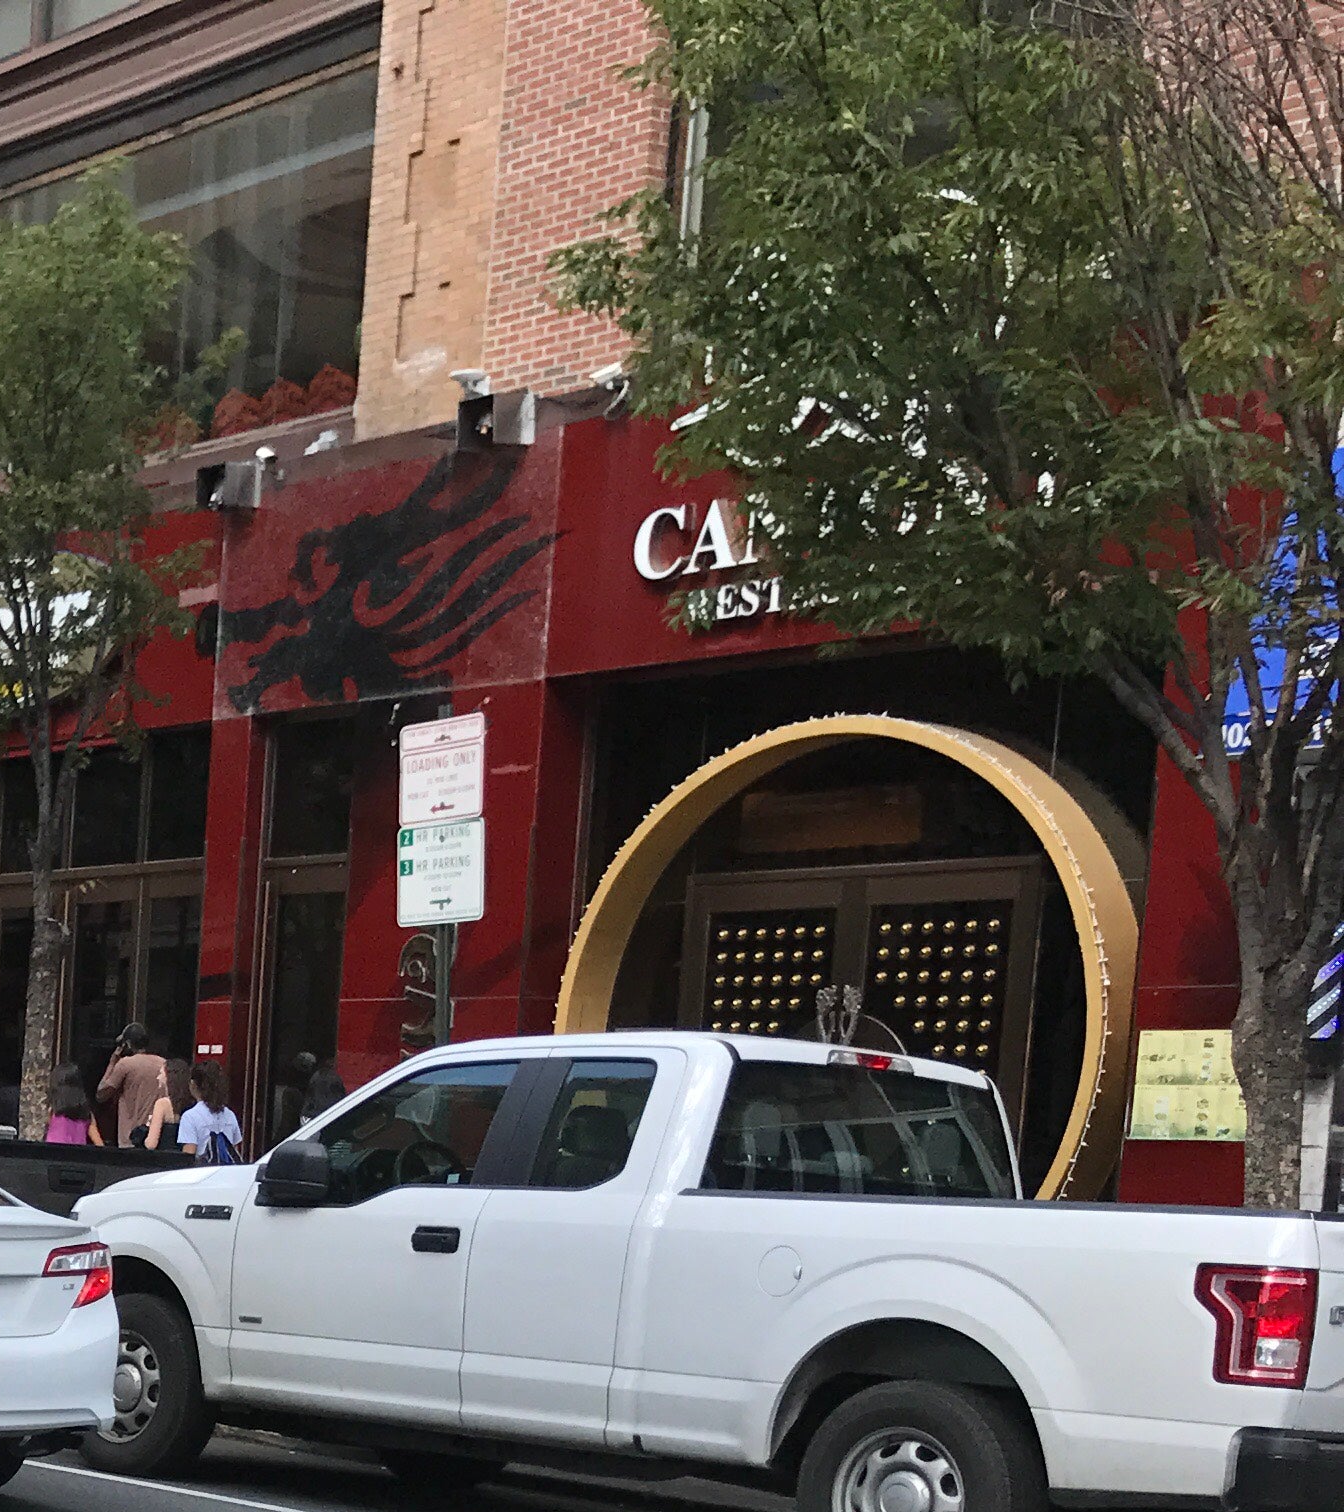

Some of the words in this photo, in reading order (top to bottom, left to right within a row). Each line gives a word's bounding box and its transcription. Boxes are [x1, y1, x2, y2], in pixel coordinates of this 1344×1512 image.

[406, 754, 450, 775] LOADING
[453, 750, 477, 767] ONLY
[432, 854, 472, 870] PARKING
